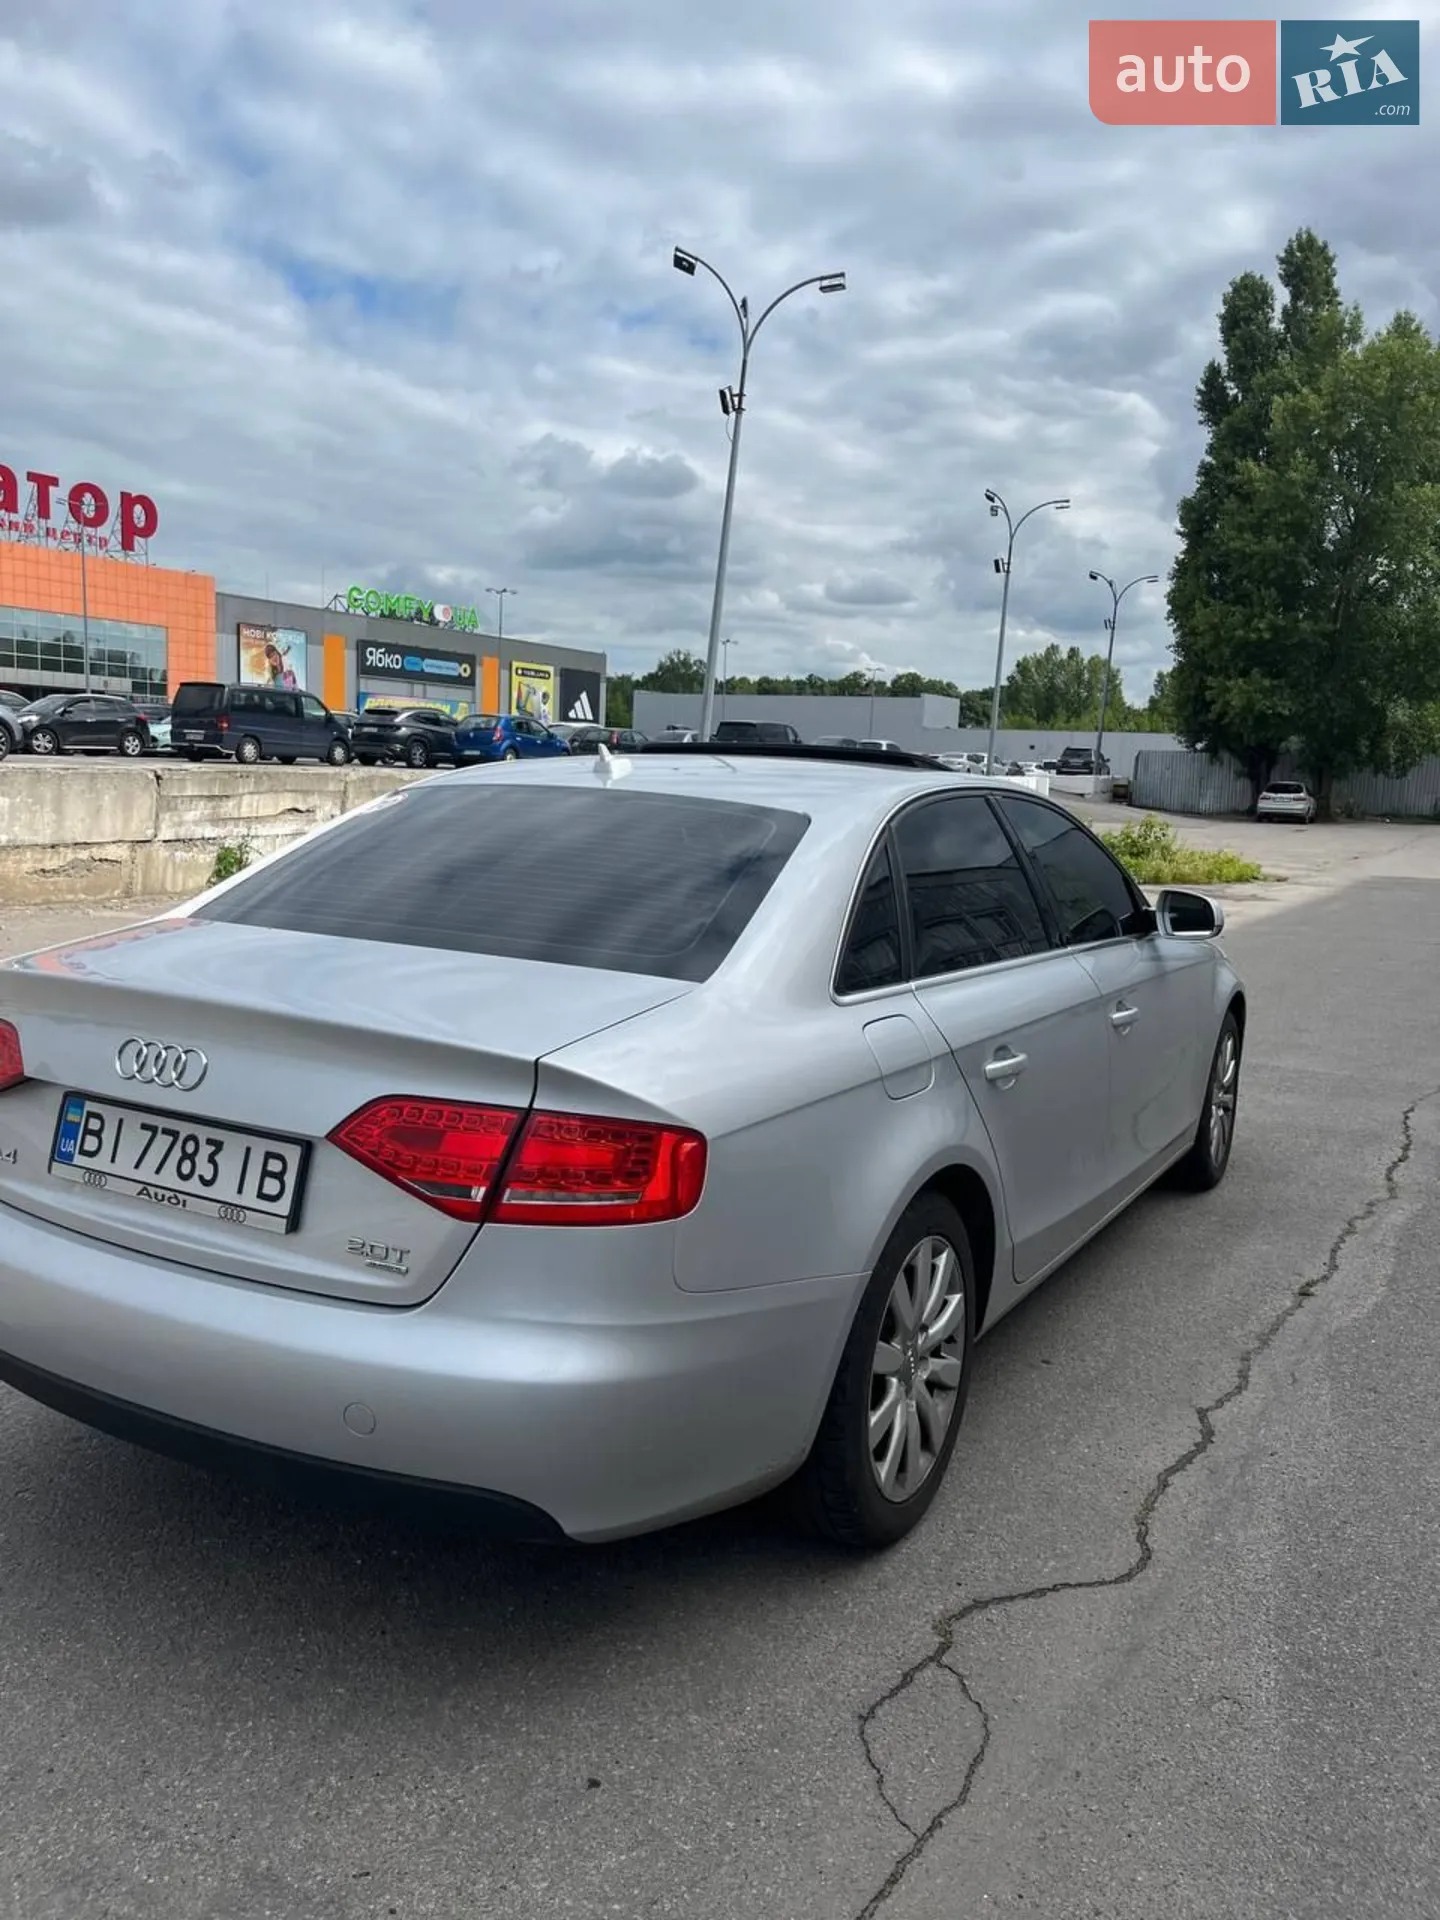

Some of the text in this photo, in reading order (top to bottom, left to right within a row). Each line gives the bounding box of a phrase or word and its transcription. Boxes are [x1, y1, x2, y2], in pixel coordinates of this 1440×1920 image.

[347, 585, 433, 621] COMFY
[365, 646, 402, 669] Ябко
[60, 1138, 75, 1154] UA
[77, 1110, 289, 1203] BI 7783 IB
[136, 1186, 188, 1208] Audi
